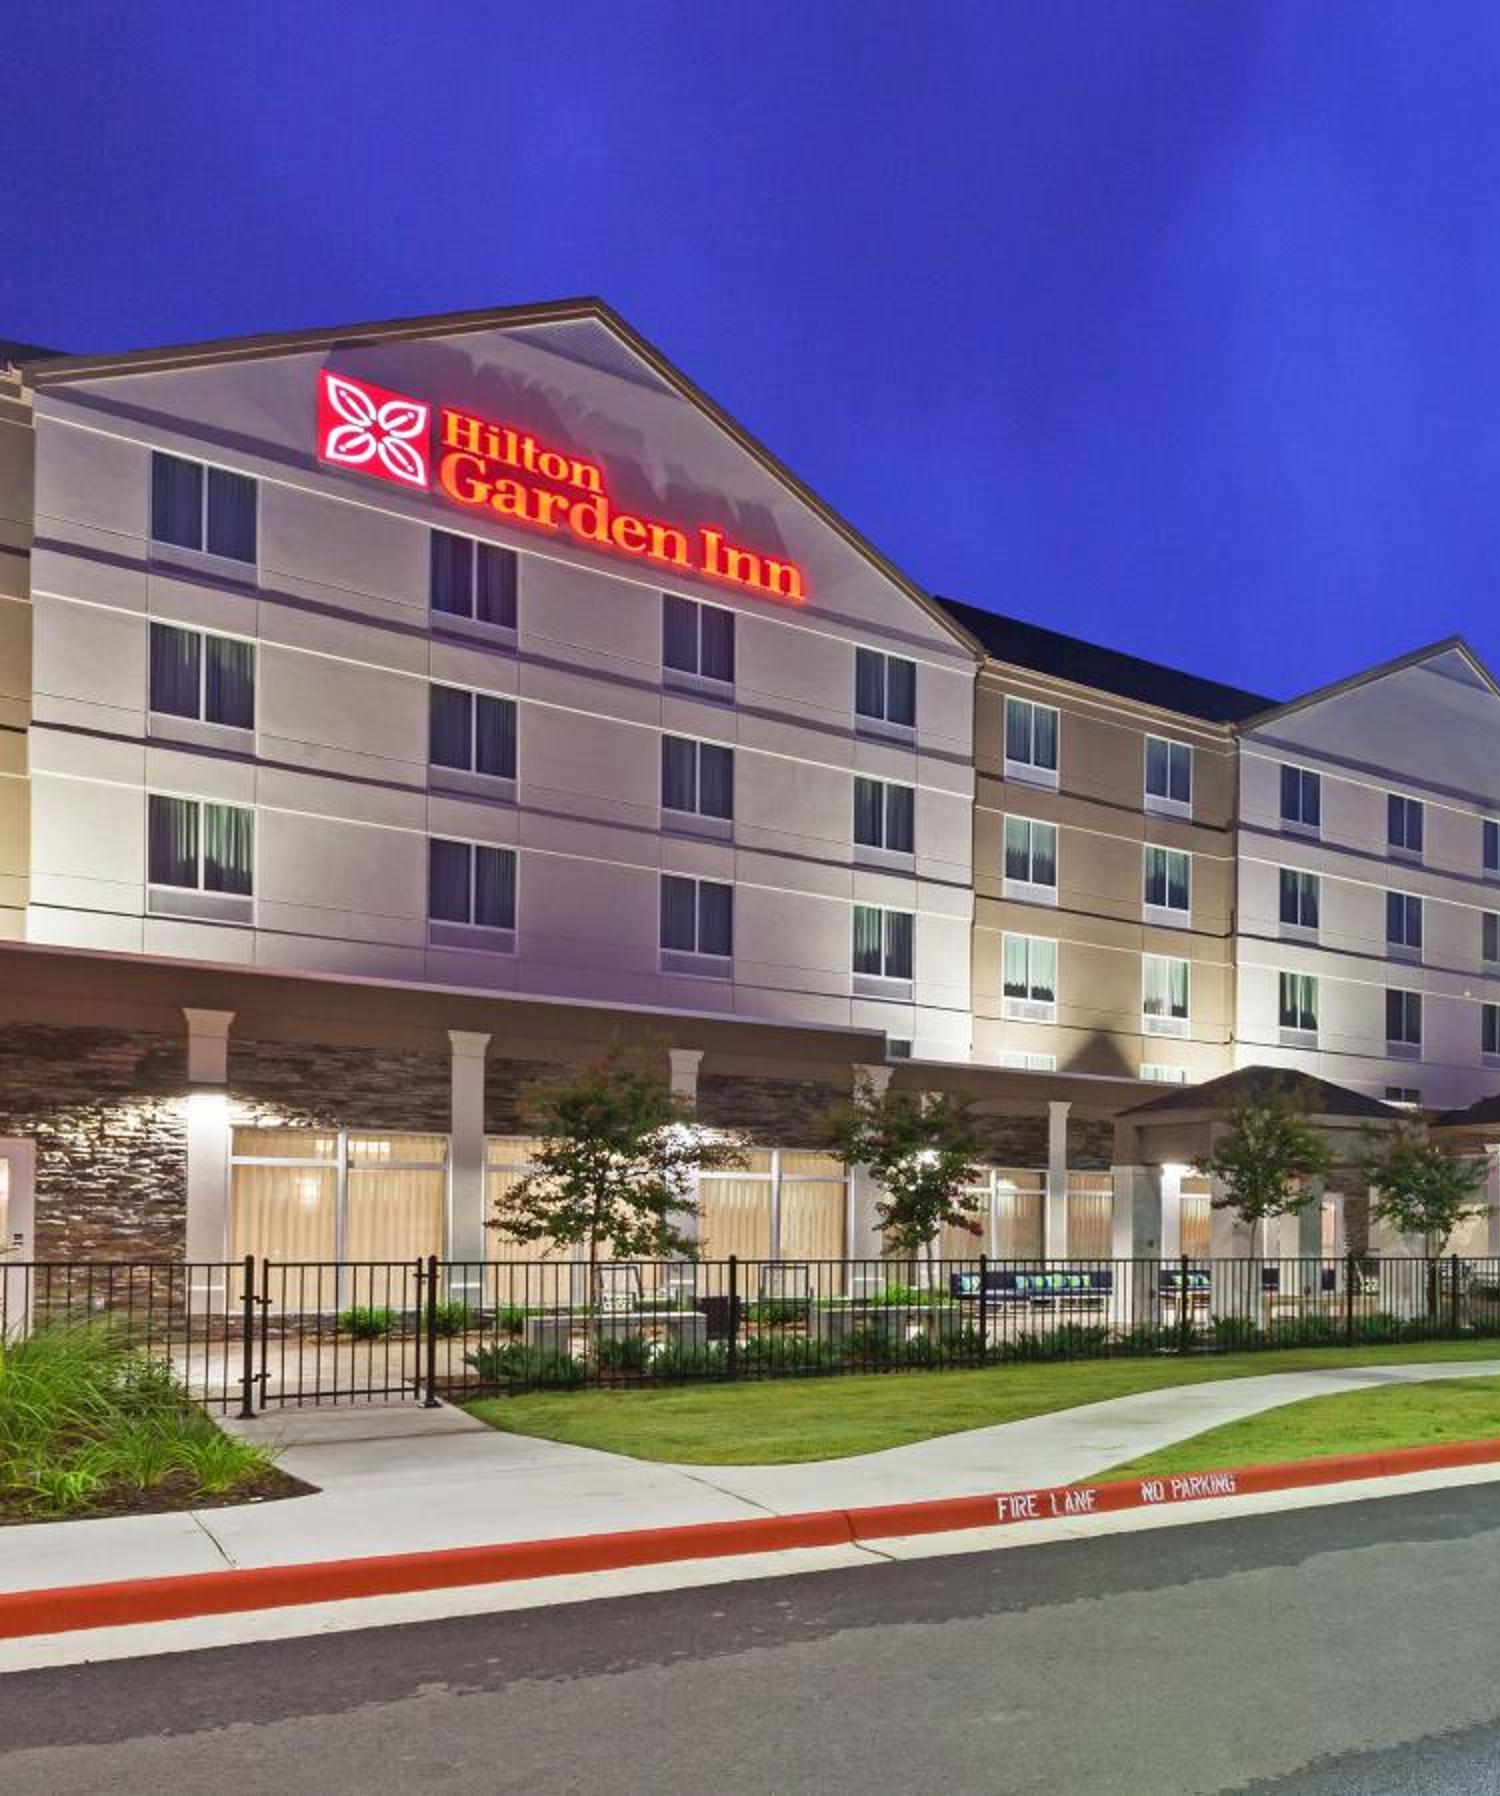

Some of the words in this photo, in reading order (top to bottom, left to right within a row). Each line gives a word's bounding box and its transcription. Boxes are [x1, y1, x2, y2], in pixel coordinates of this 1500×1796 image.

[441, 410, 604, 492] Hilton
[440, 452, 692, 568] Garden
[699, 528, 805, 601] Inn
[996, 1495, 1040, 1521] FIRE
[1050, 1489, 1096, 1515] LANE
[1141, 1481, 1165, 1501] NO
[1171, 1473, 1236, 1500] PARKING
